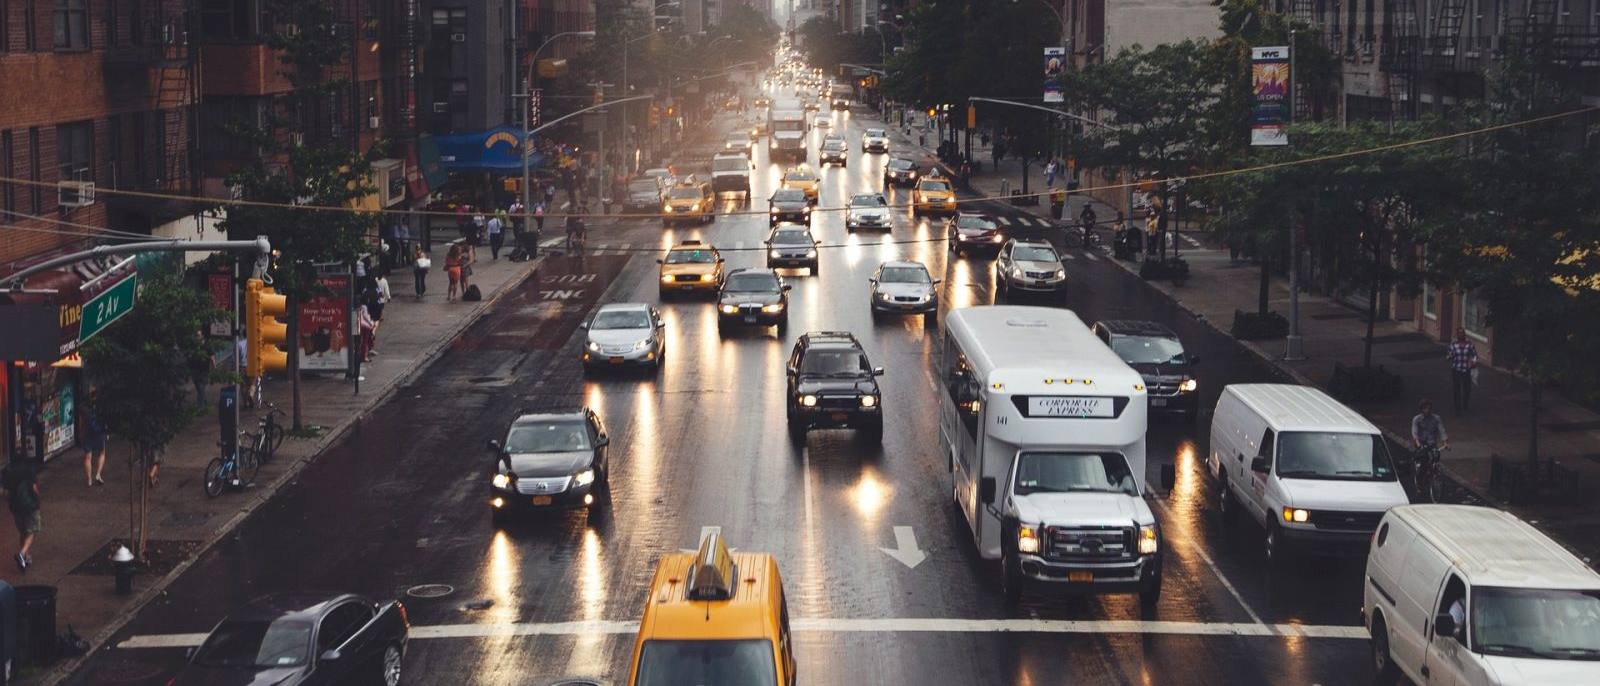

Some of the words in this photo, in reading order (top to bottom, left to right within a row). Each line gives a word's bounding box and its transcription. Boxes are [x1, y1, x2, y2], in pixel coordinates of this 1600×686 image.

[97, 302, 104, 324] 2
[105, 295, 120, 319] Av
[226, 398, 233, 407] P
[1039, 399, 1100, 407] CORPORATE
[1048, 407, 1095, 415] EXPRESS
[997, 415, 1008, 425] 141
